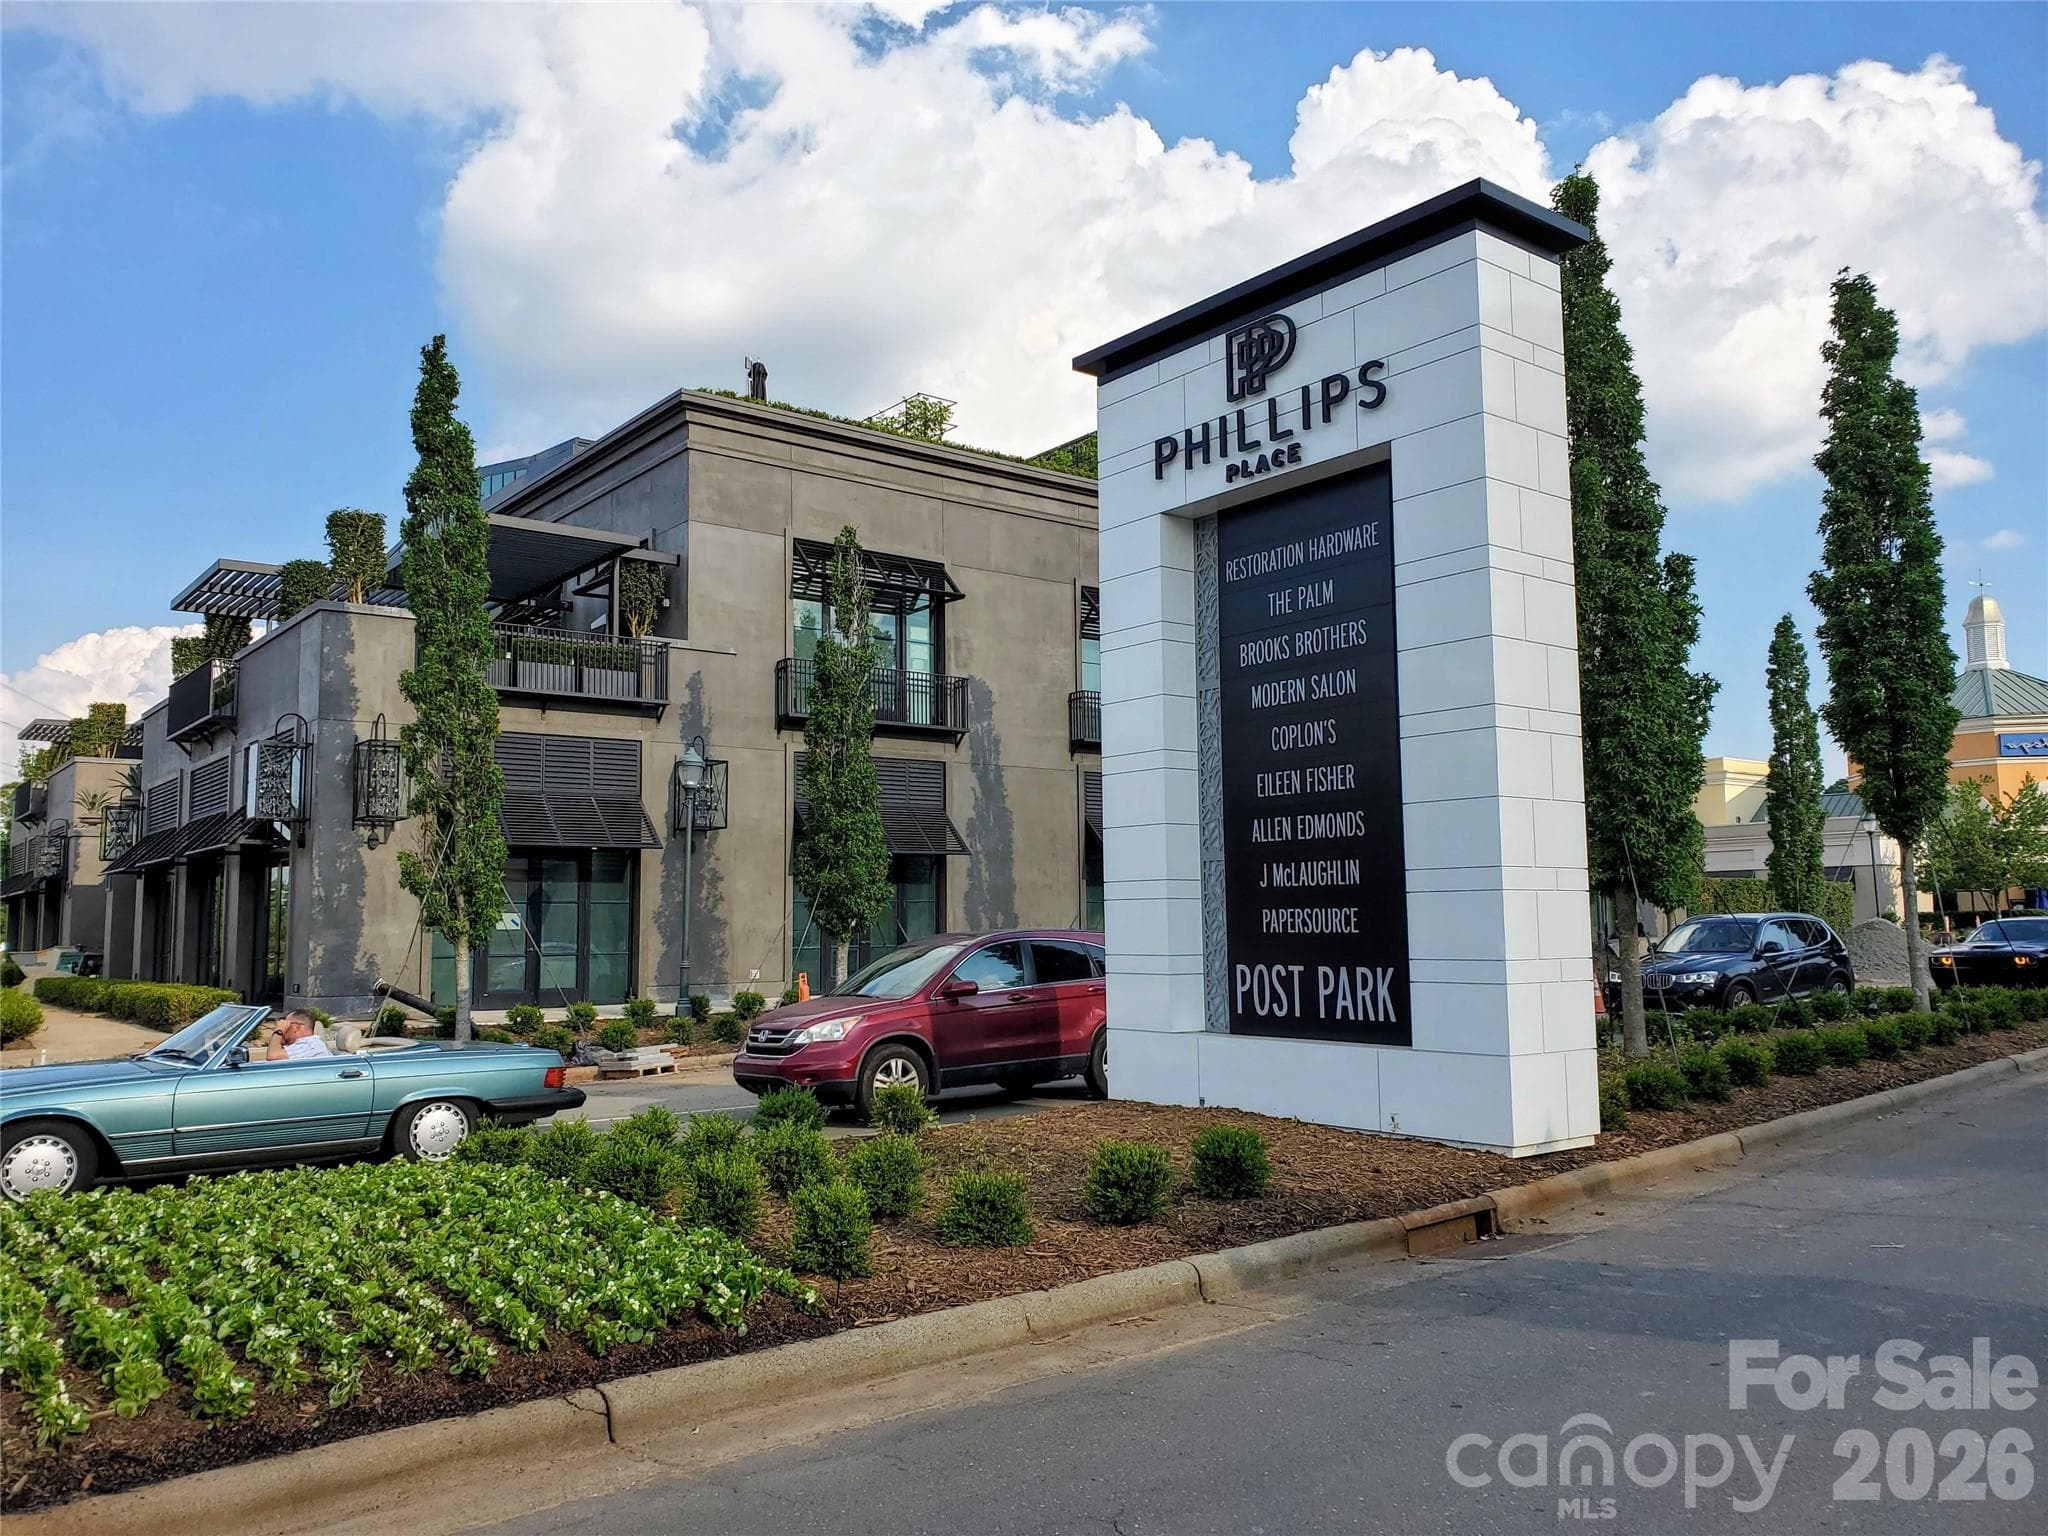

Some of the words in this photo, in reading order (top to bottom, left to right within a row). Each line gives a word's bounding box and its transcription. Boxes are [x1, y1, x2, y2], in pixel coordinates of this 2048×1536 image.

[1155, 360, 1388, 480] PHILLIPS
[1226, 442, 1301, 483] PLACE
[1226, 541, 1304, 583] RESTORATION
[1309, 521, 1380, 562] HARDWARE
[1268, 589, 1293, 616] THE
[1299, 579, 1334, 610] PALM
[1240, 635, 1290, 667] BROOKS
[1296, 619, 1367, 657] BROTHERS
[1252, 677, 1306, 710] MODERN
[1311, 668, 1356, 700] SALON
[1271, 719, 1337, 751] COPLON'S
[1257, 769, 1300, 797] EILEEN
[1307, 764, 1355, 793] FISHER
[1252, 816, 1291, 842] ALLEN
[1298, 810, 1365, 840] EDMONDS
[1260, 864, 1267, 888] J
[1274, 859, 1360, 887] McLAUGHLIN
[1262, 908, 1359, 934] PAPERSOURCE
[1236, 964, 1304, 1017] POST
[1318, 966, 1397, 1022] PARK
